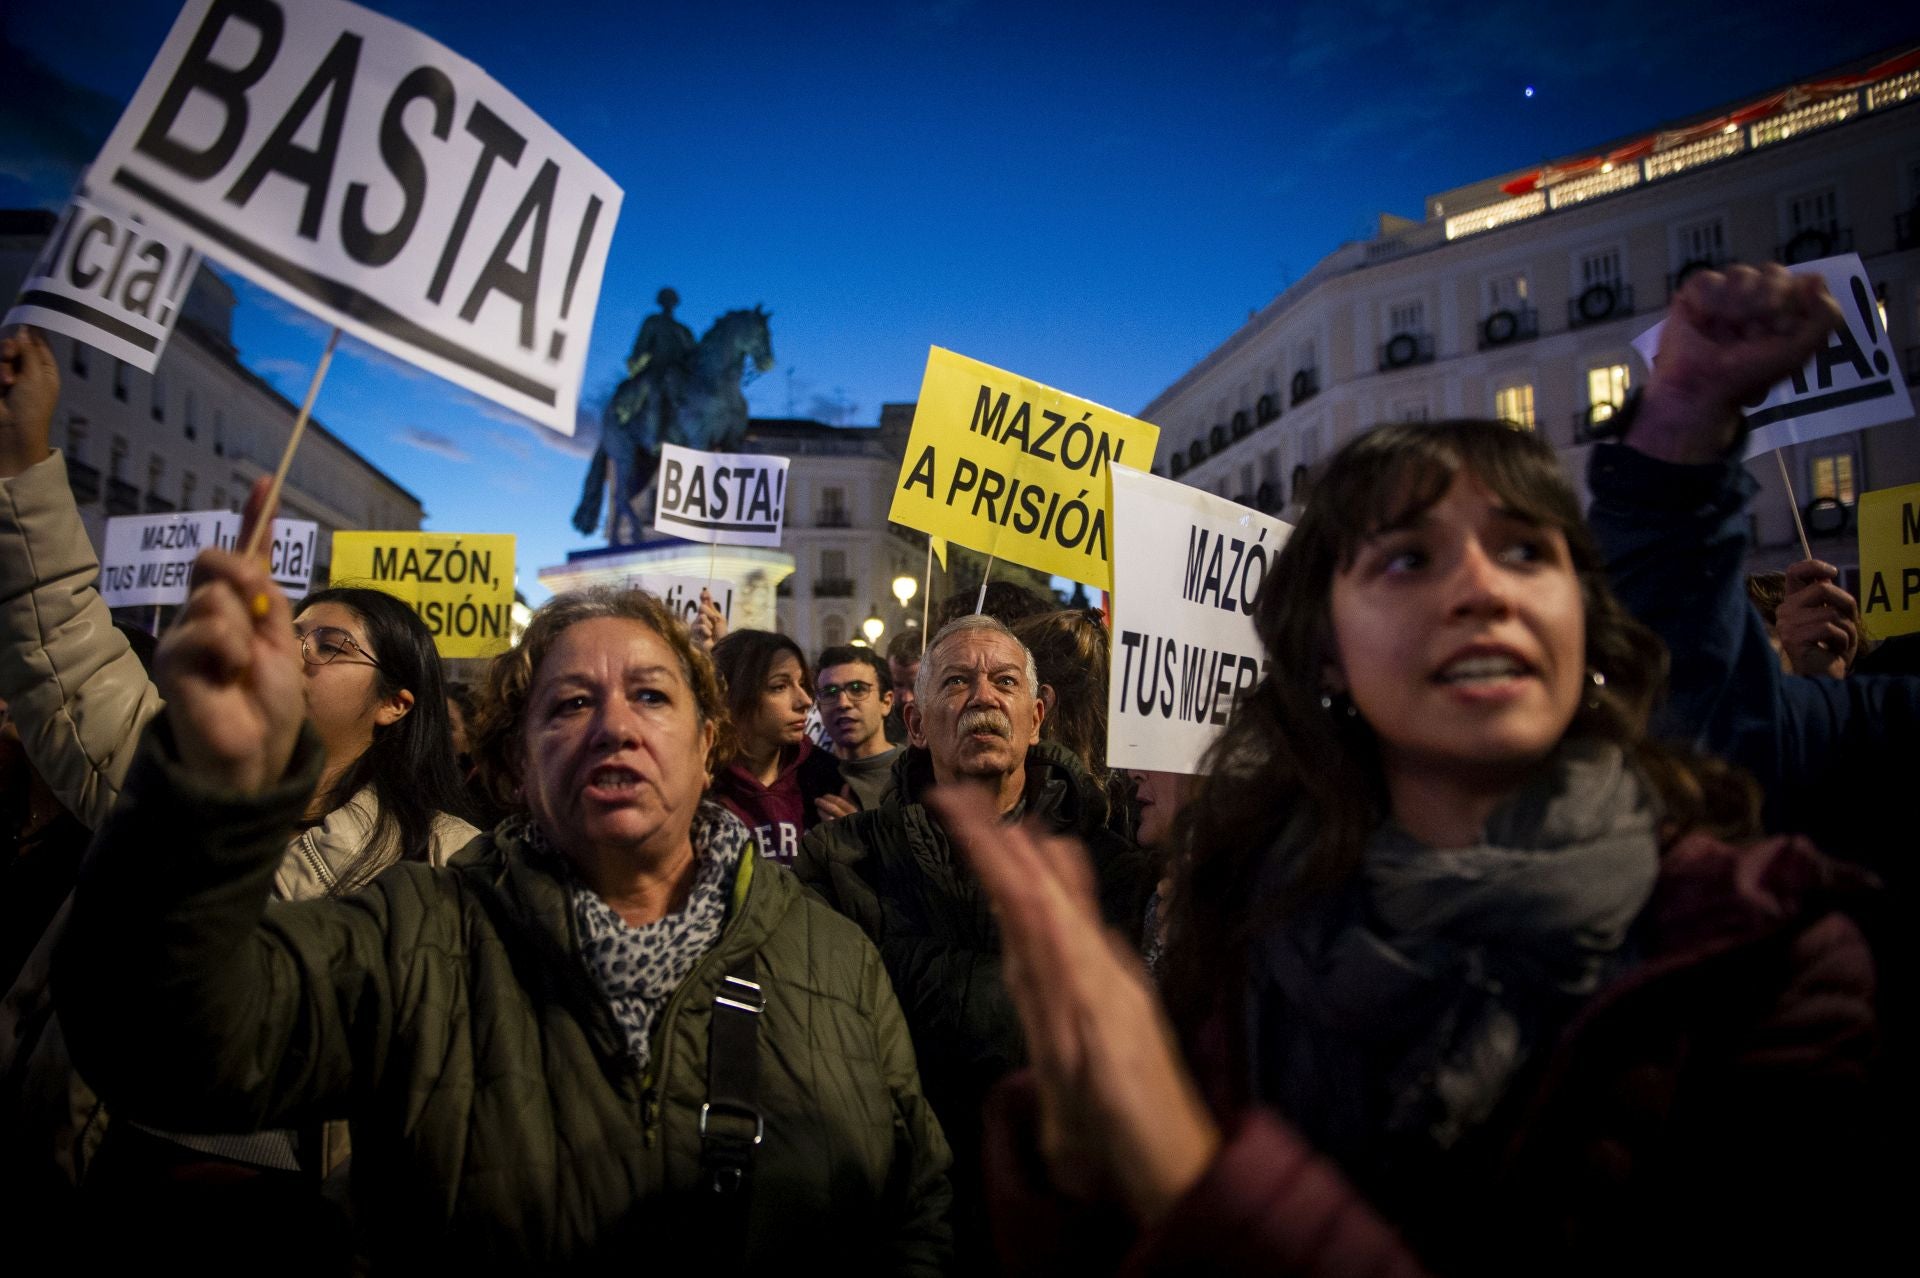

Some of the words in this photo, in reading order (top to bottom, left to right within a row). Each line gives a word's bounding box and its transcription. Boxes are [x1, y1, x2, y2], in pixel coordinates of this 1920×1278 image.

[134, 0, 603, 362] BASTA!
[47, 186, 195, 327] icia!
[661, 458, 784, 523] BASTA!
[903, 445, 936, 499] A
[105, 565, 136, 592] TUS
[136, 560, 195, 589] MUERT
[372, 541, 500, 591] MAZÓN,
[1183, 524, 1280, 616] MAZÓ
[1865, 571, 1892, 613] A
[1120, 630, 1177, 719] TUS
[1179, 644, 1272, 727] MUER
[754, 822, 798, 858] ER
